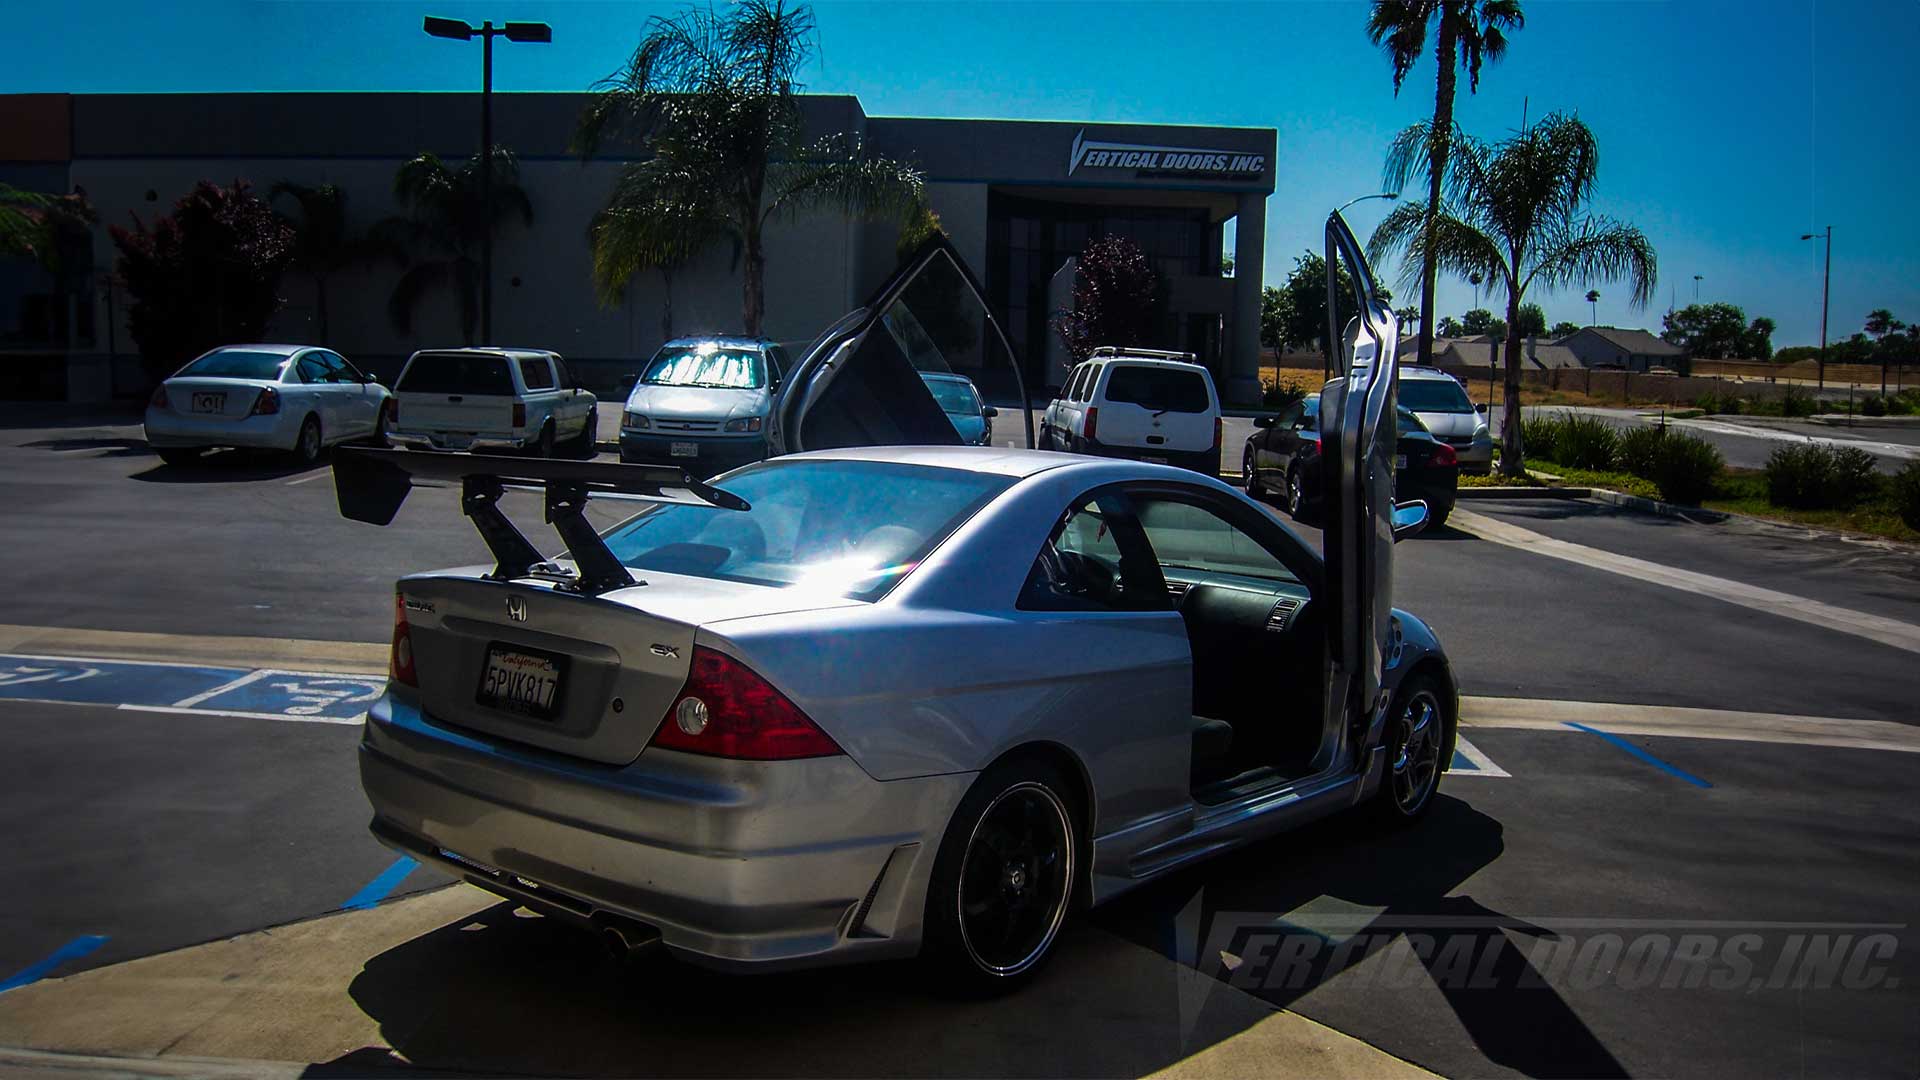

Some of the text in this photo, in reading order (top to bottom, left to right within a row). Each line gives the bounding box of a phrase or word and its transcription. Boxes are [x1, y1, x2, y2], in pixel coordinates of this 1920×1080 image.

[1068, 127, 1159, 177] VERTICAL
[650, 643, 680, 659] EX
[486, 666, 557, 710] 5PVK817
